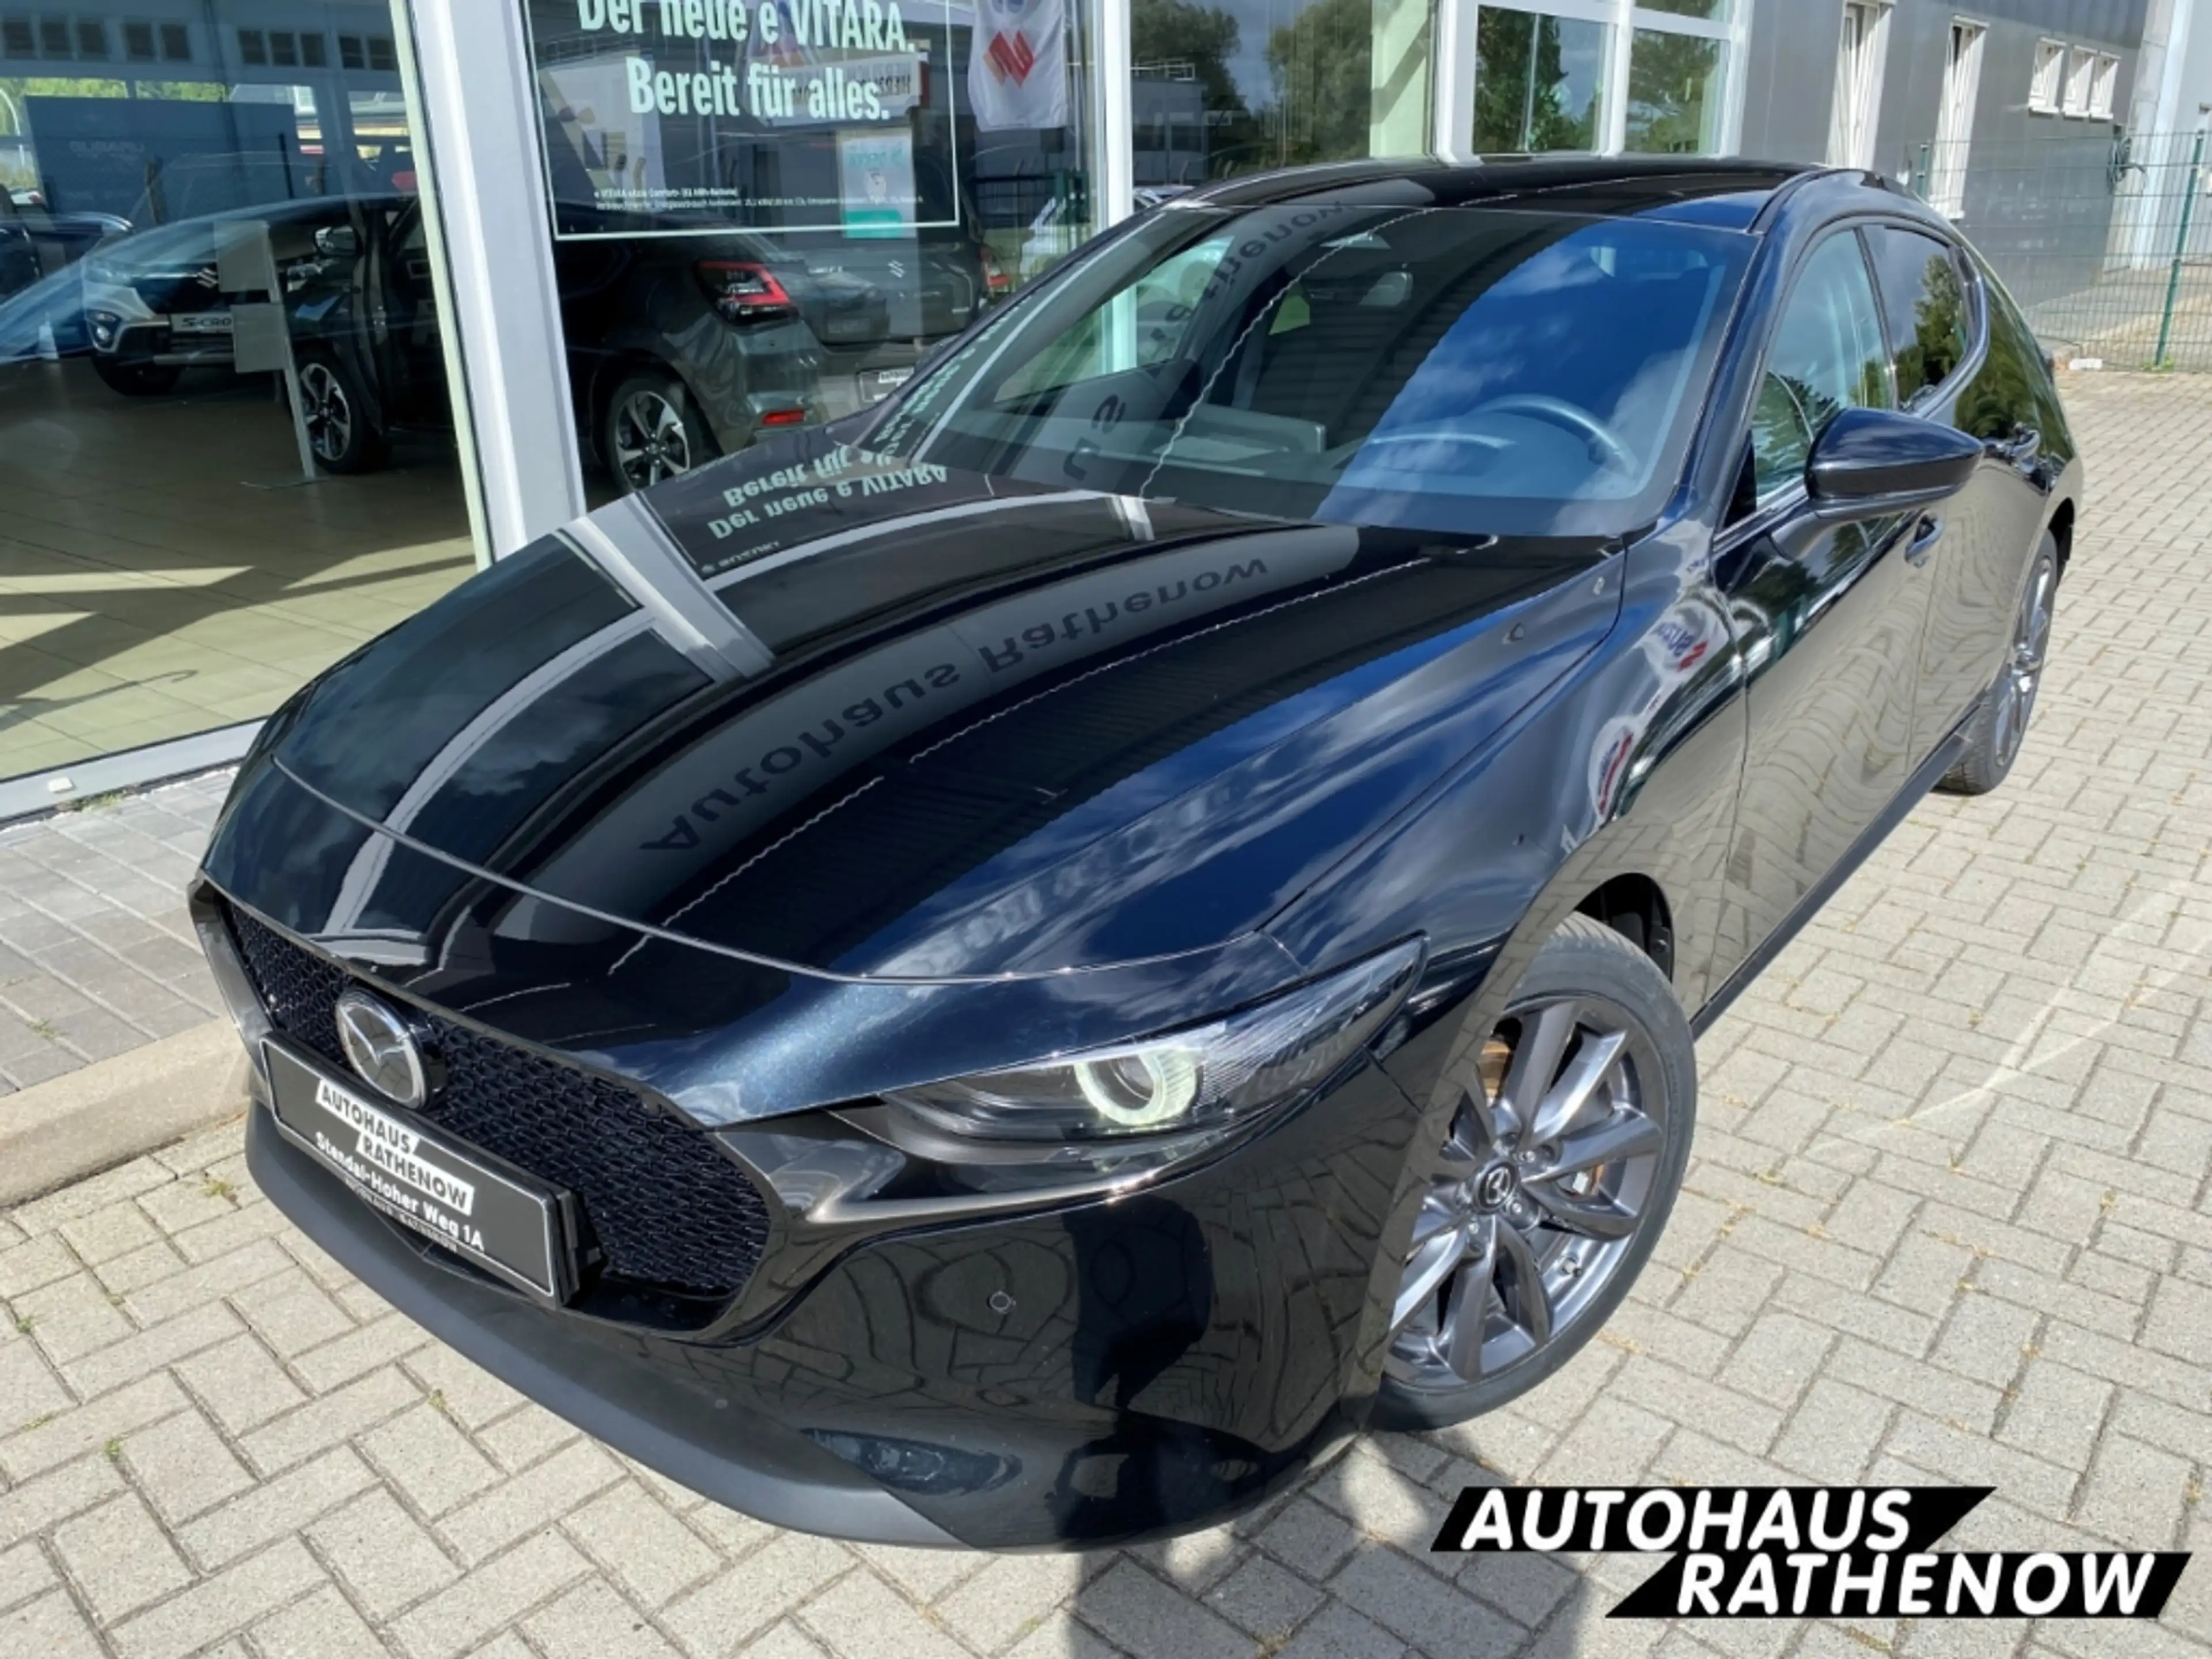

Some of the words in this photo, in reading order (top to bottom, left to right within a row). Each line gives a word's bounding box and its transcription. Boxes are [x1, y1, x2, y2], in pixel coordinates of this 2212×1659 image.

[578, 0, 638, 33] Der
[660, 0, 748, 41] neue
[759, 1, 778, 44] e
[790, 0, 915, 51] VITARA.
[625, 56, 740, 116] Bereit
[748, 62, 796, 117] für
[808, 67, 889, 120] alles.
[320, 1084, 411, 1154] AUTOHAUS
[363, 1134, 468, 1209] RATHENOW
[422, 1200, 459, 1239] Weg
[463, 1224, 485, 1252] 1A
